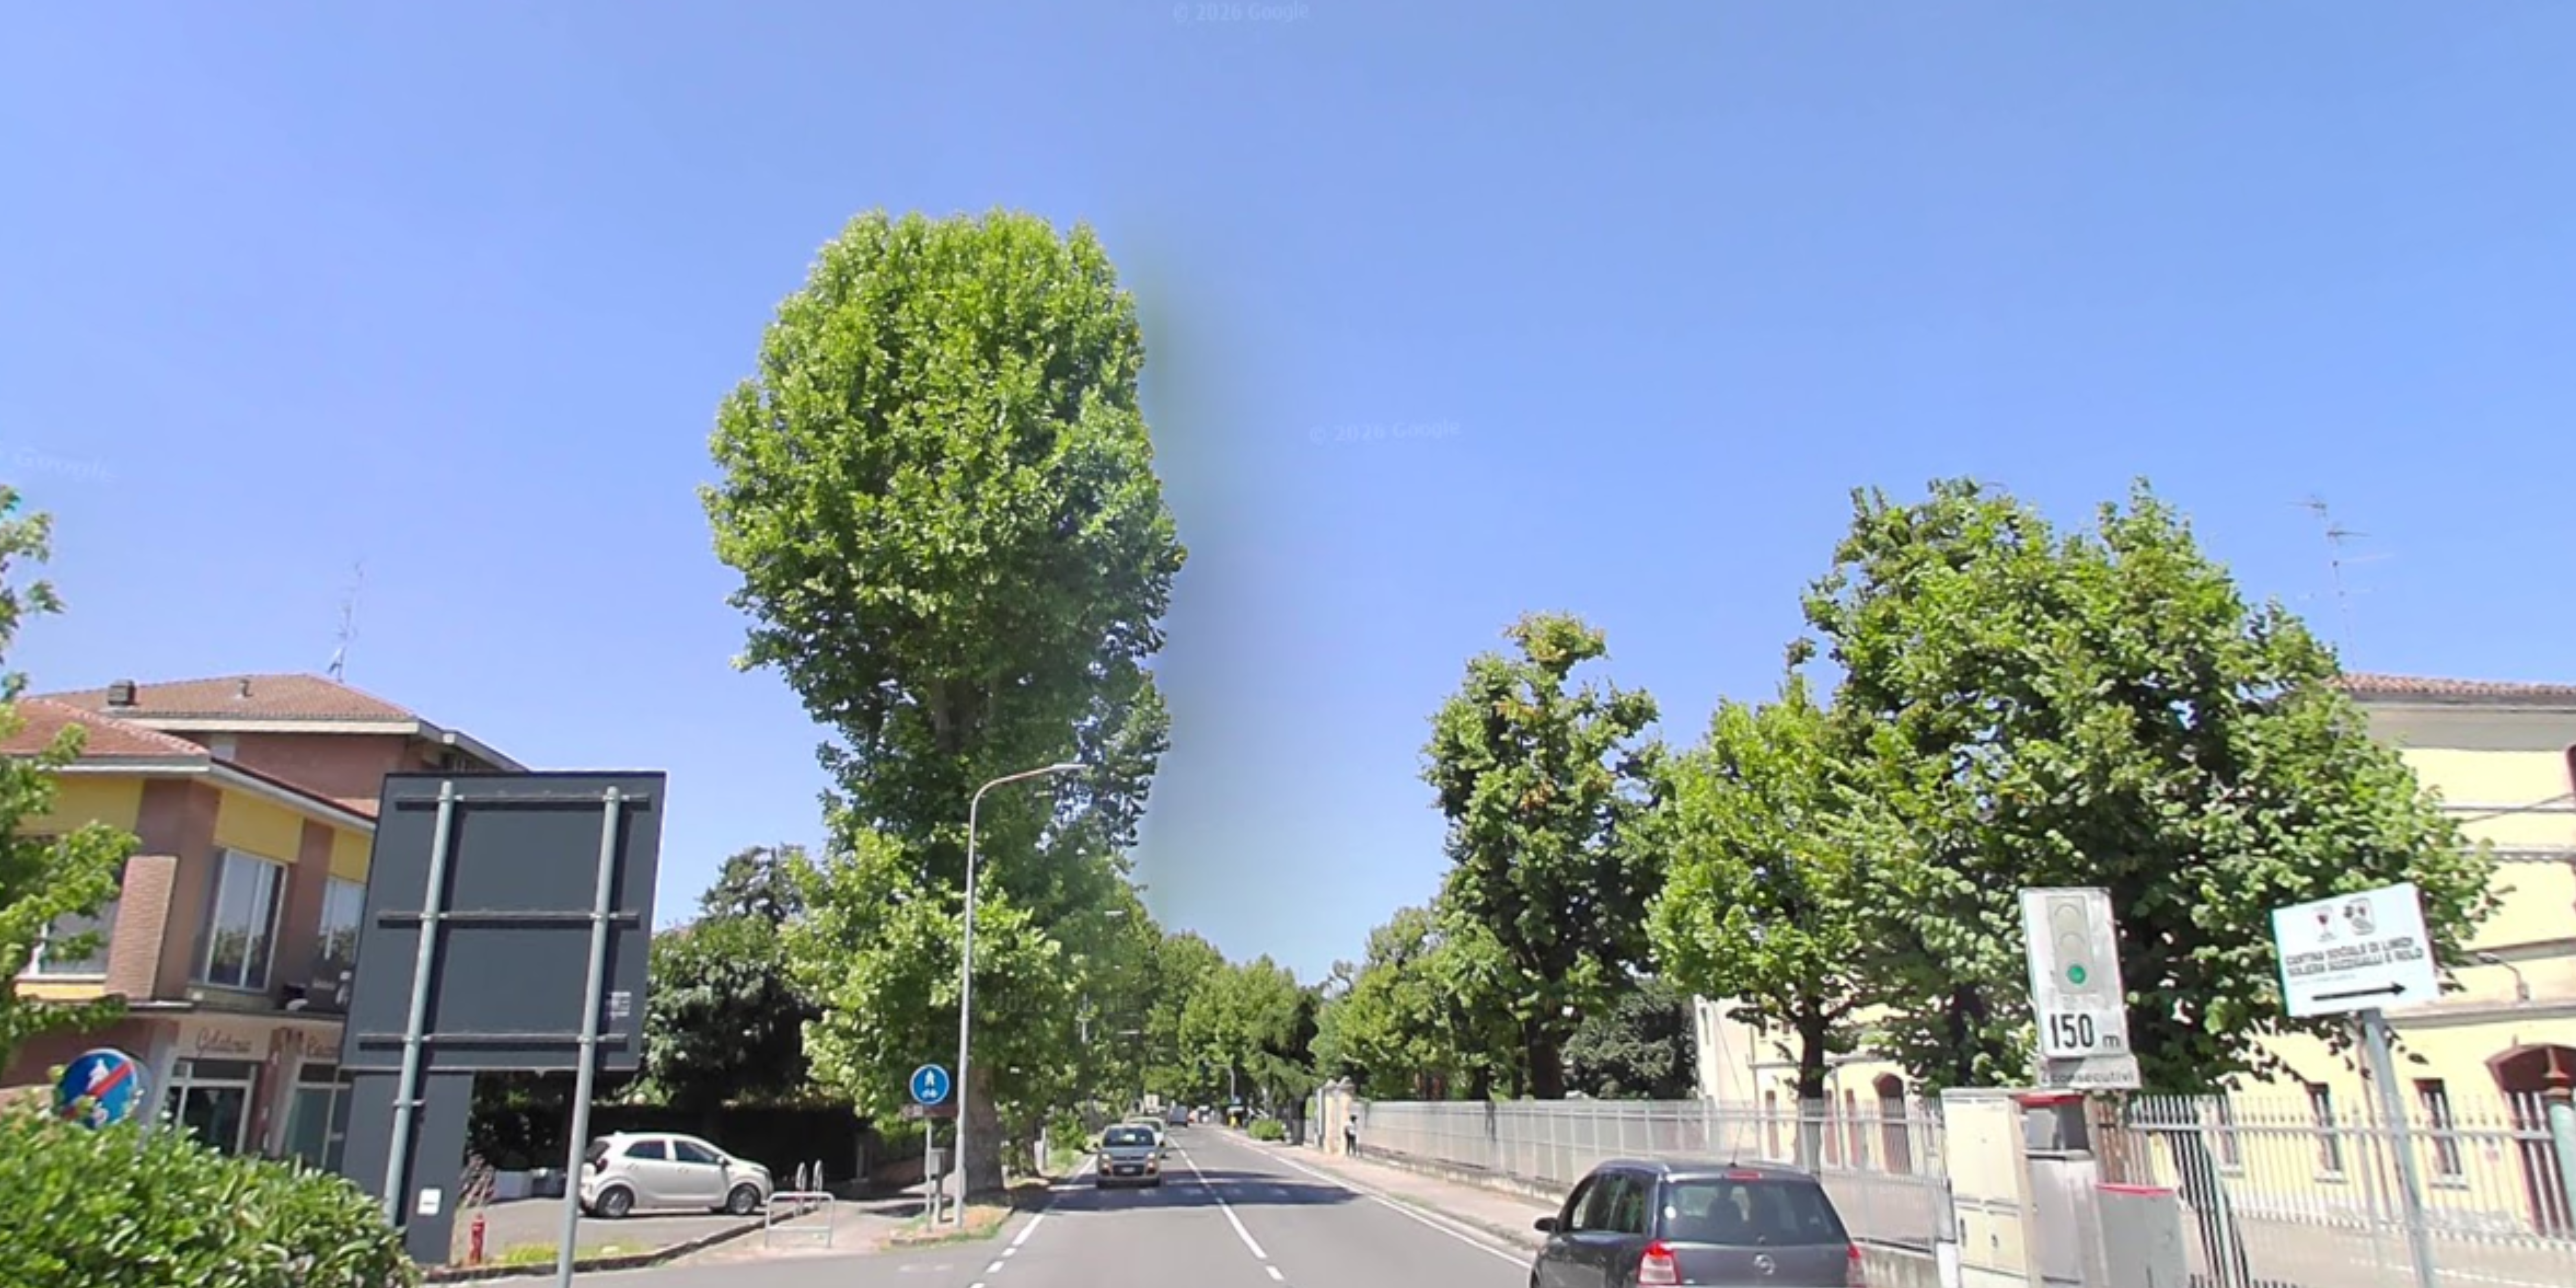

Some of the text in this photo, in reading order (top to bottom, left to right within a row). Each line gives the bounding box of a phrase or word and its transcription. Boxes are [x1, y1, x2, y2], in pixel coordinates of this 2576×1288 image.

[2051, 1014, 2121, 1049] 150 m
[2051, 1070, 2134, 1083] consecutivi
